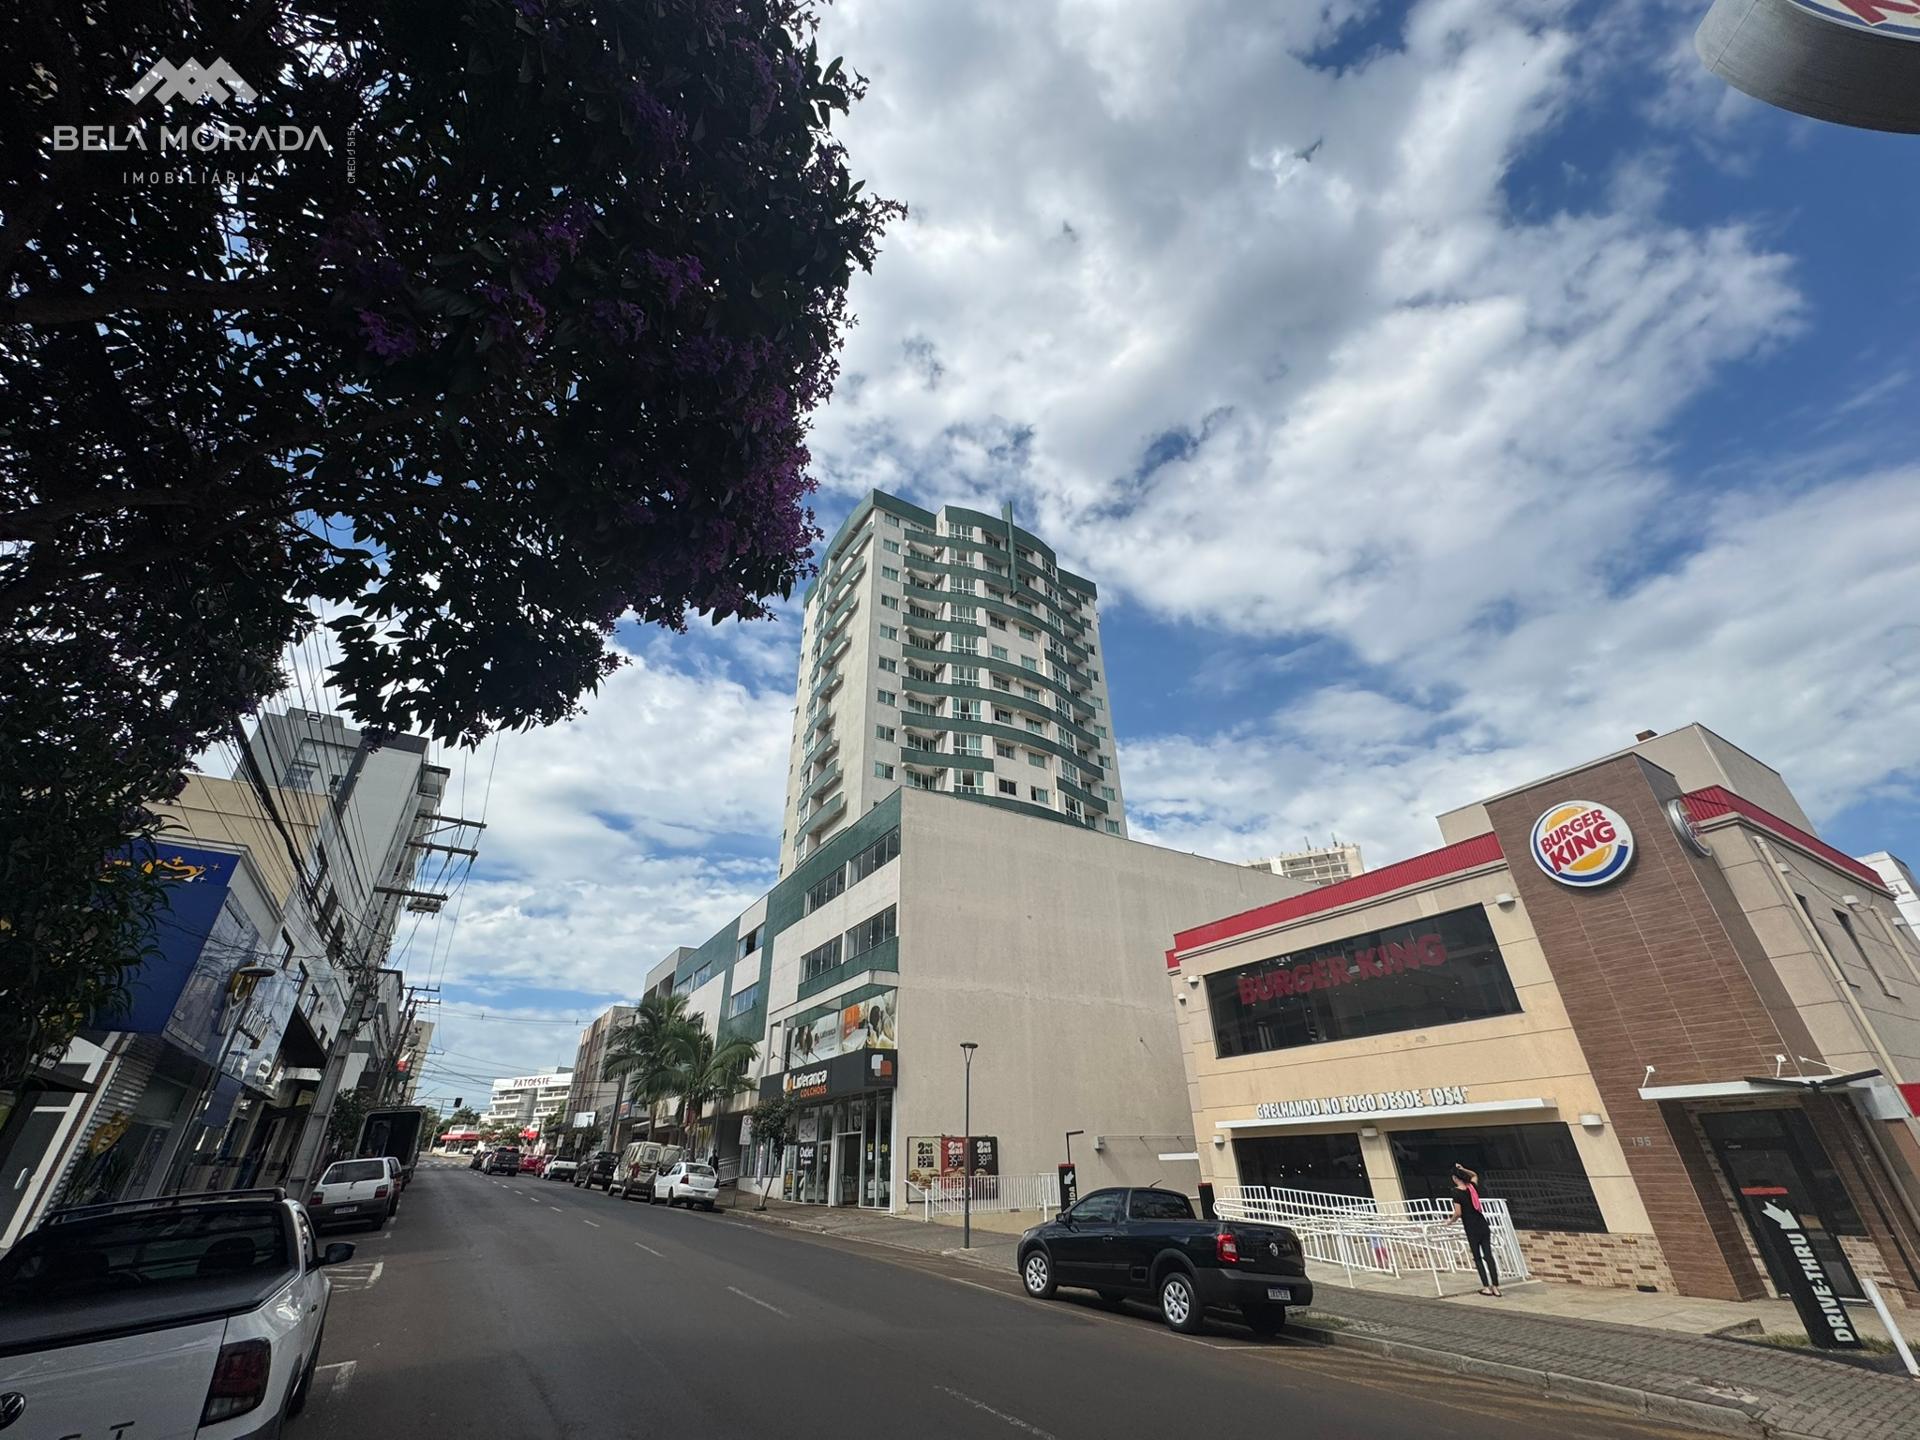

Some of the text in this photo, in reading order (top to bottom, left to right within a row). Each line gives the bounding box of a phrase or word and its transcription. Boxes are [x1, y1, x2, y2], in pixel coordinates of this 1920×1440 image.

[1540, 808, 1607, 852] BURGER
[1549, 821, 1617, 874] KING
[1237, 933, 1447, 1006] BURGER KING
[513, 1076, 551, 1088] PATOESTE
[792, 1069, 828, 1090] Liderança
[1256, 1098, 1320, 1120] GRELHANDO
[1321, 1096, 1342, 1115] NO
[1343, 1093, 1377, 1113] FOGO
[1378, 1090, 1424, 1110] DESDE
[799, 1146, 814, 1158] Outlet
[918, 1142, 925, 1154] 2
[948, 1141, 955, 1154] 2
[977, 1141, 984, 1153] 2
[1785, 1233, 1857, 1343] DRIVE-THRU
